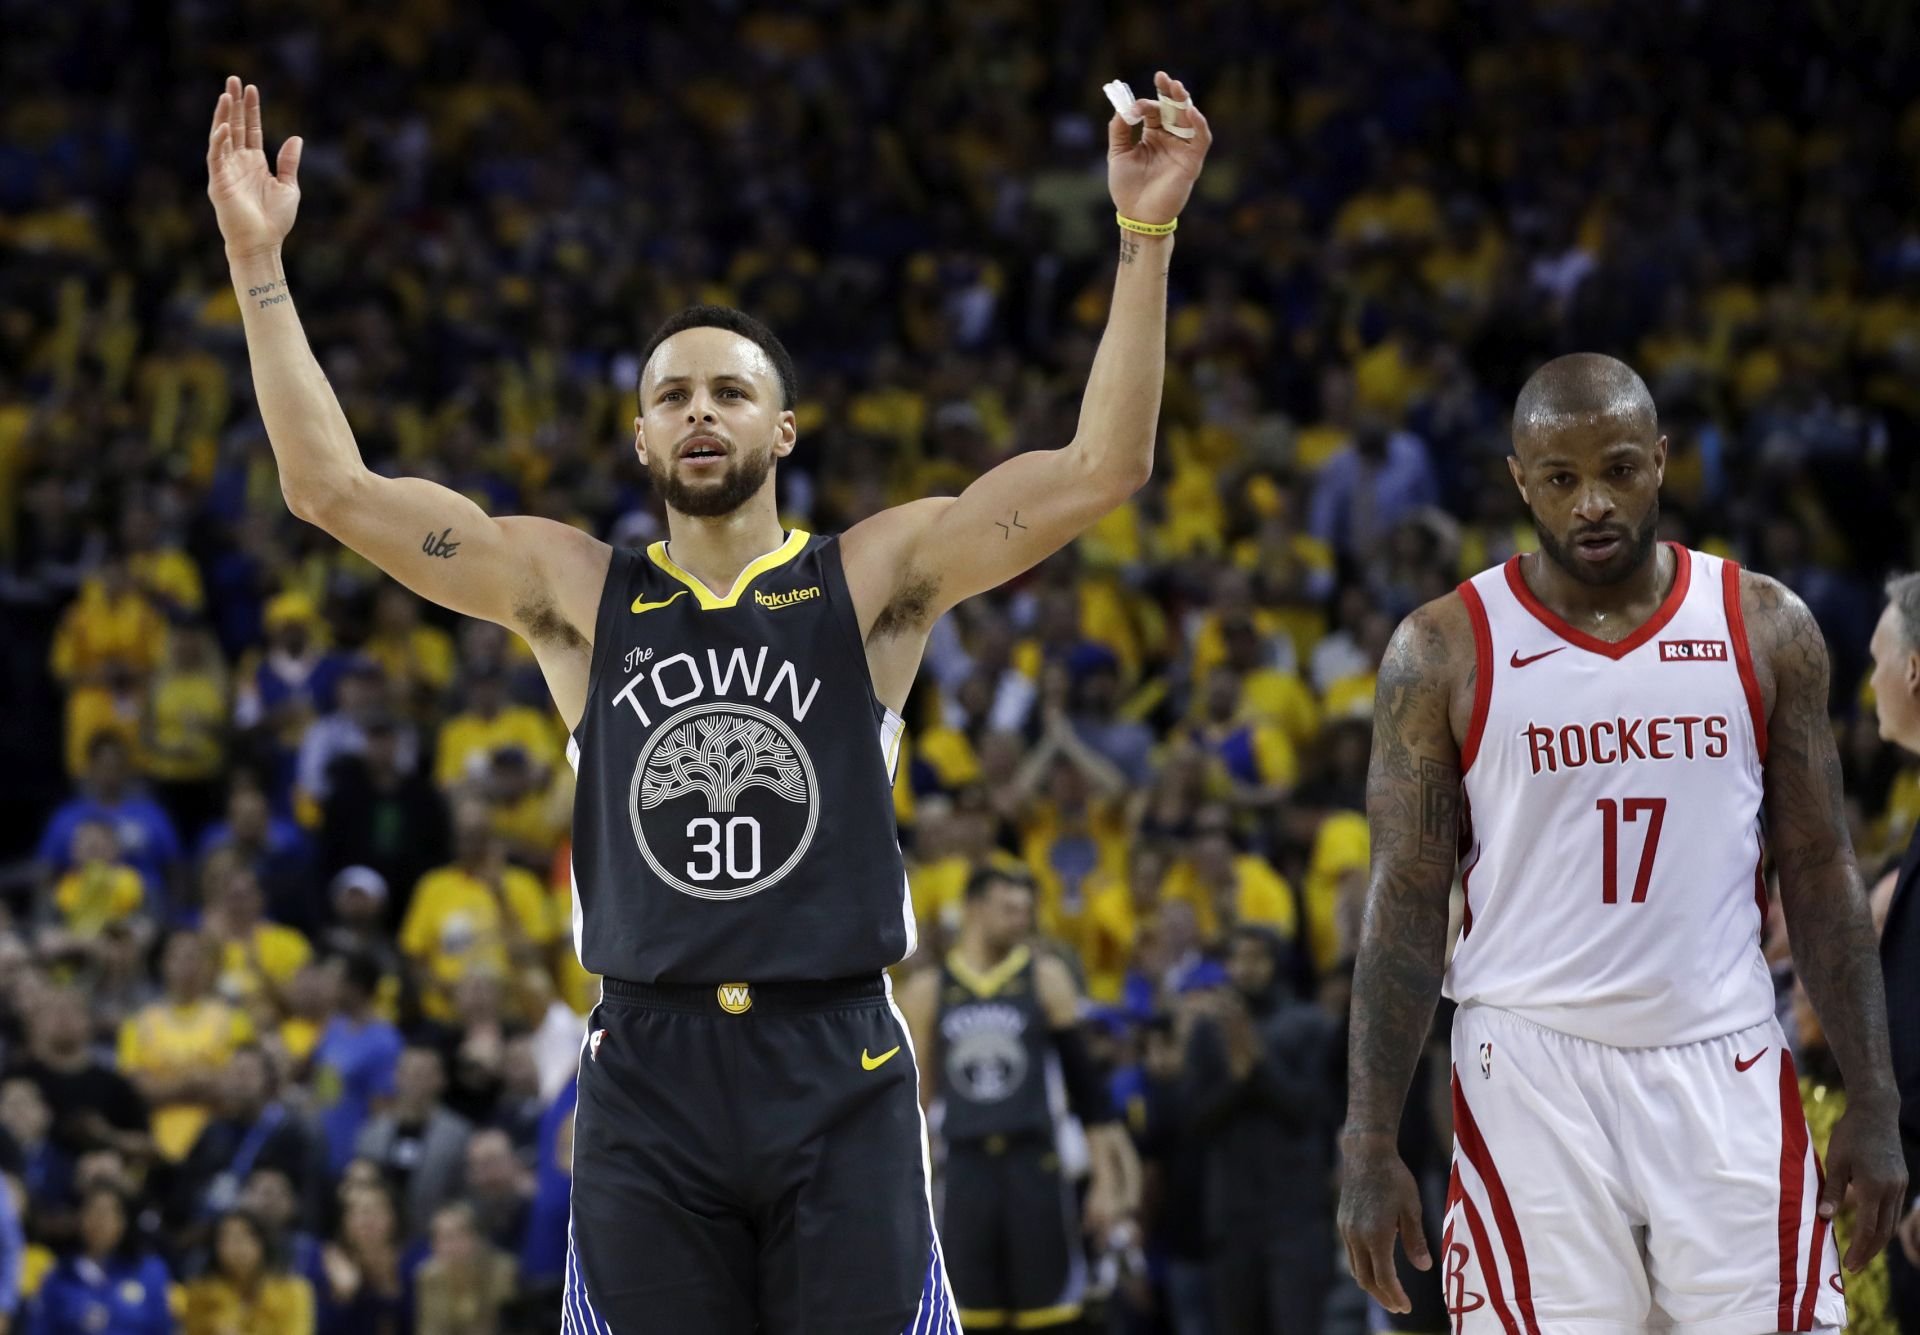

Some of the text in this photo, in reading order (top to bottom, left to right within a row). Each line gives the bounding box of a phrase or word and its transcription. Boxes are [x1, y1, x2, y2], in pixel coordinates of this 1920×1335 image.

[754, 586, 820, 607] Rakuten
[611, 646, 821, 728] TOWN
[623, 645, 654, 673] The
[1518, 715, 1729, 776] ROCKETS
[686, 816, 761, 881] 30
[1595, 797, 1667, 904] 17
[721, 986, 750, 1006] W
